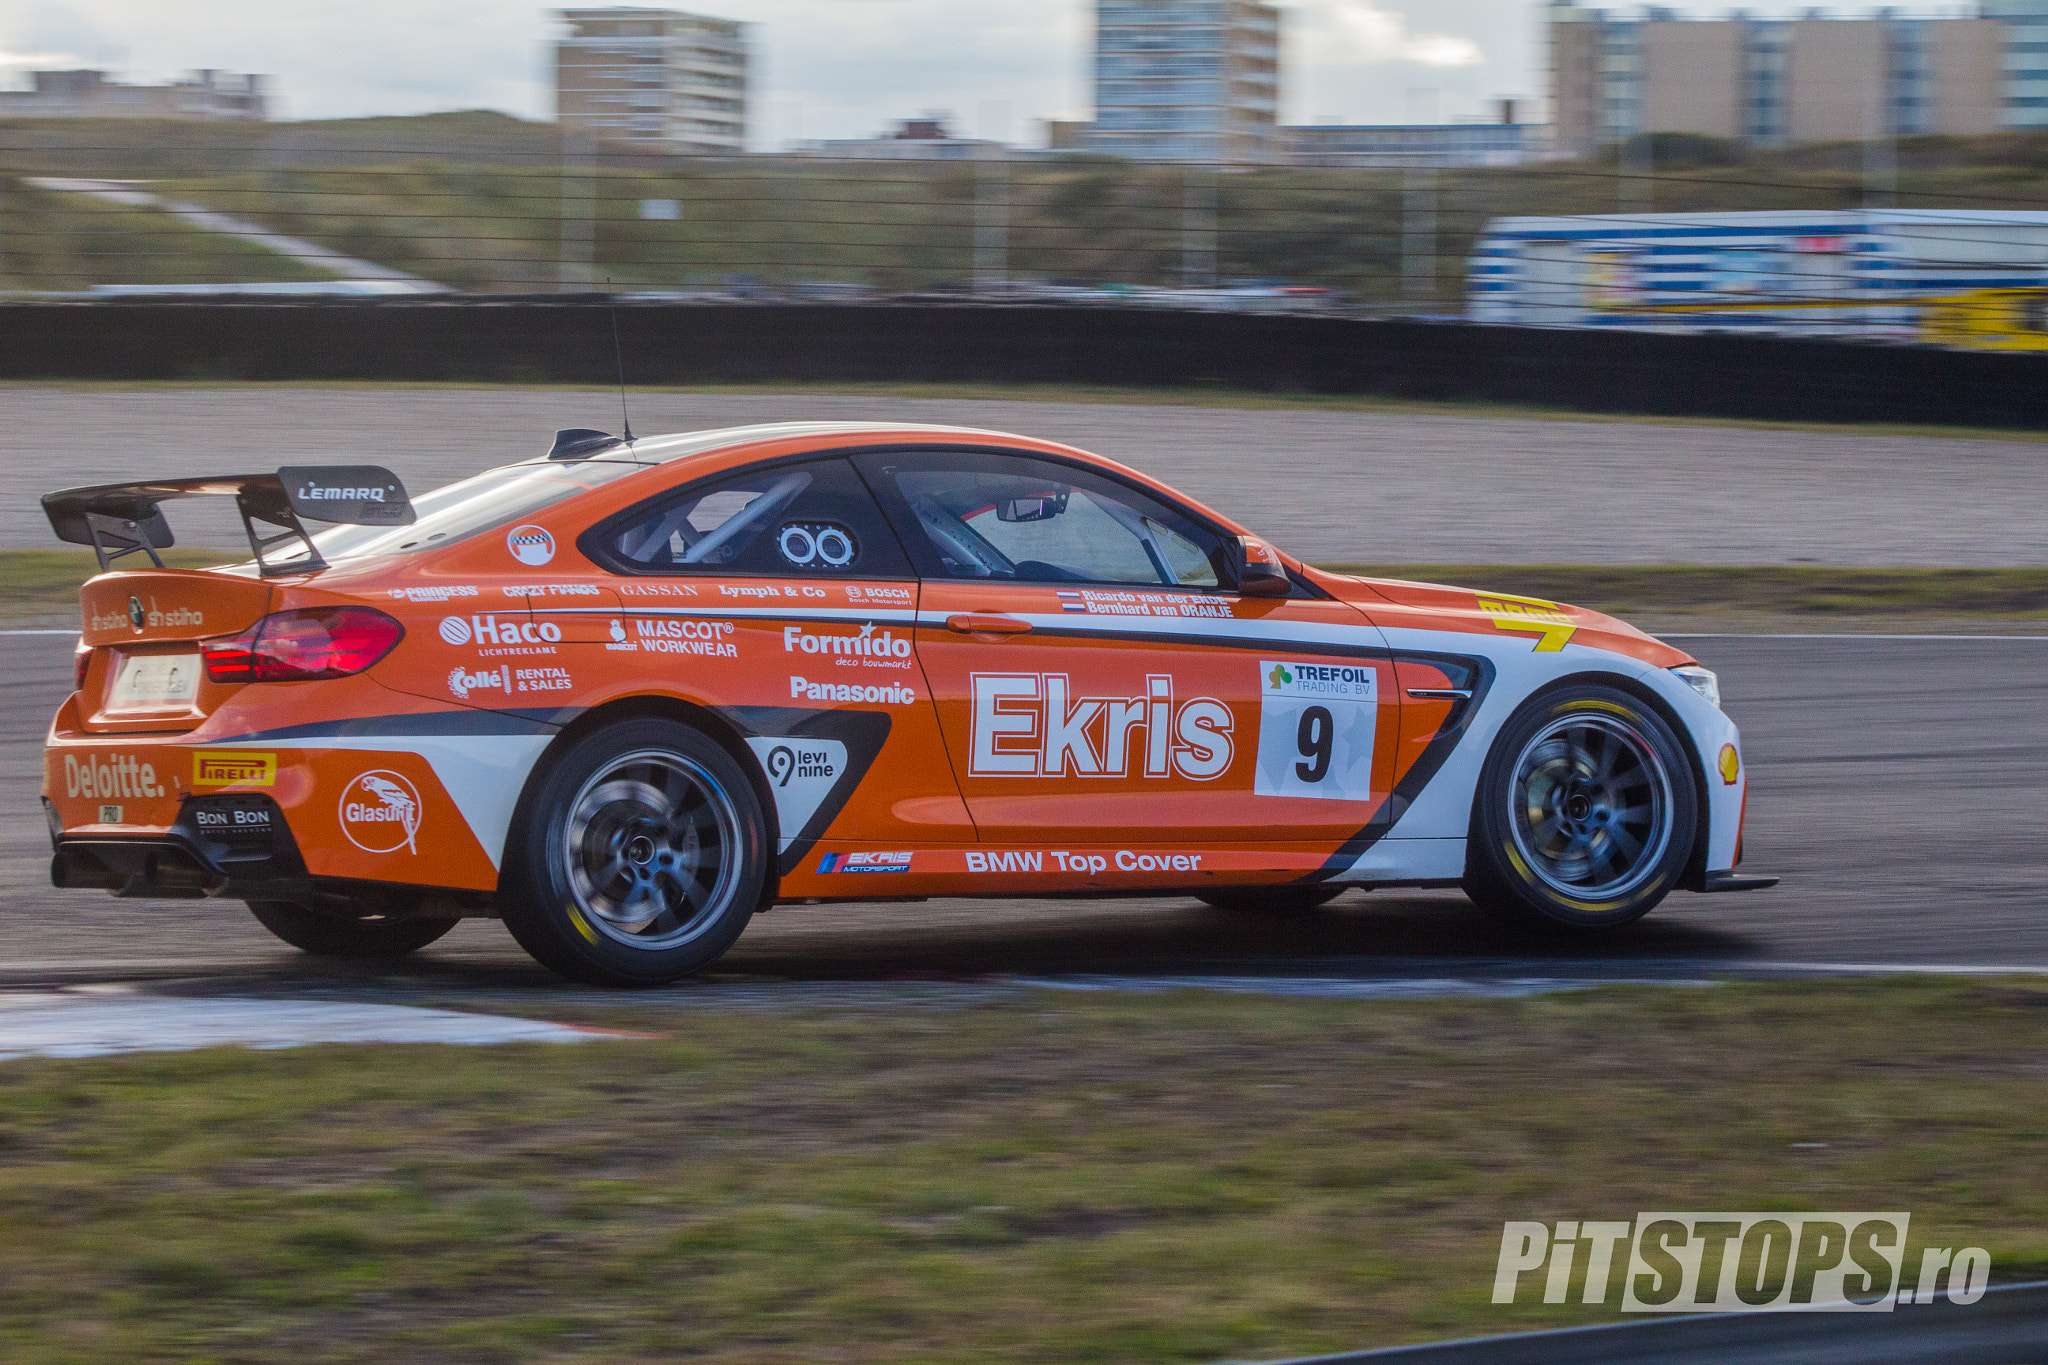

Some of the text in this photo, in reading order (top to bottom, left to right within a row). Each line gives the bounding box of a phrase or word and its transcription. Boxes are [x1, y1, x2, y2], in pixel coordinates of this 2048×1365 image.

[297, 487, 386, 503] LEMARQ
[405, 585, 479, 598] PRINCESS
[502, 585, 546, 598] CRAZY
[620, 585, 698, 596] GASSAN
[718, 585, 826, 598] Lymph & Co
[865, 588, 910, 598] BOSCH
[1081, 590, 1135, 602] Ricardo
[1138, 594, 1163, 604] van
[1165, 593, 1188, 604] der
[1086, 601, 1234, 617] Bernhard van ORANJE
[472, 615, 561, 644] Haco
[784, 622, 911, 657] Formido
[478, 646, 557, 656] LICHTREKLAME
[641, 639, 738, 658] WORKWEAR
[835, 656, 911, 670] deco bouwmarkt
[515, 668, 570, 679] RENTAL
[1294, 665, 1370, 684] TREFOIL
[518, 679, 572, 691] & SALES
[790, 676, 914, 704] Panasonic
[1295, 680, 1370, 695] TRADING BV
[968, 671, 1234, 781] Ekris
[1295, 705, 1334, 783] 9
[798, 750, 827, 764] levi
[64, 753, 166, 798] Deloitte.
[200, 758, 266, 780] PIRELLI
[798, 764, 834, 777] nine
[847, 852, 913, 864] EKRIS
[965, 850, 1202, 875] BMW Top Cover
